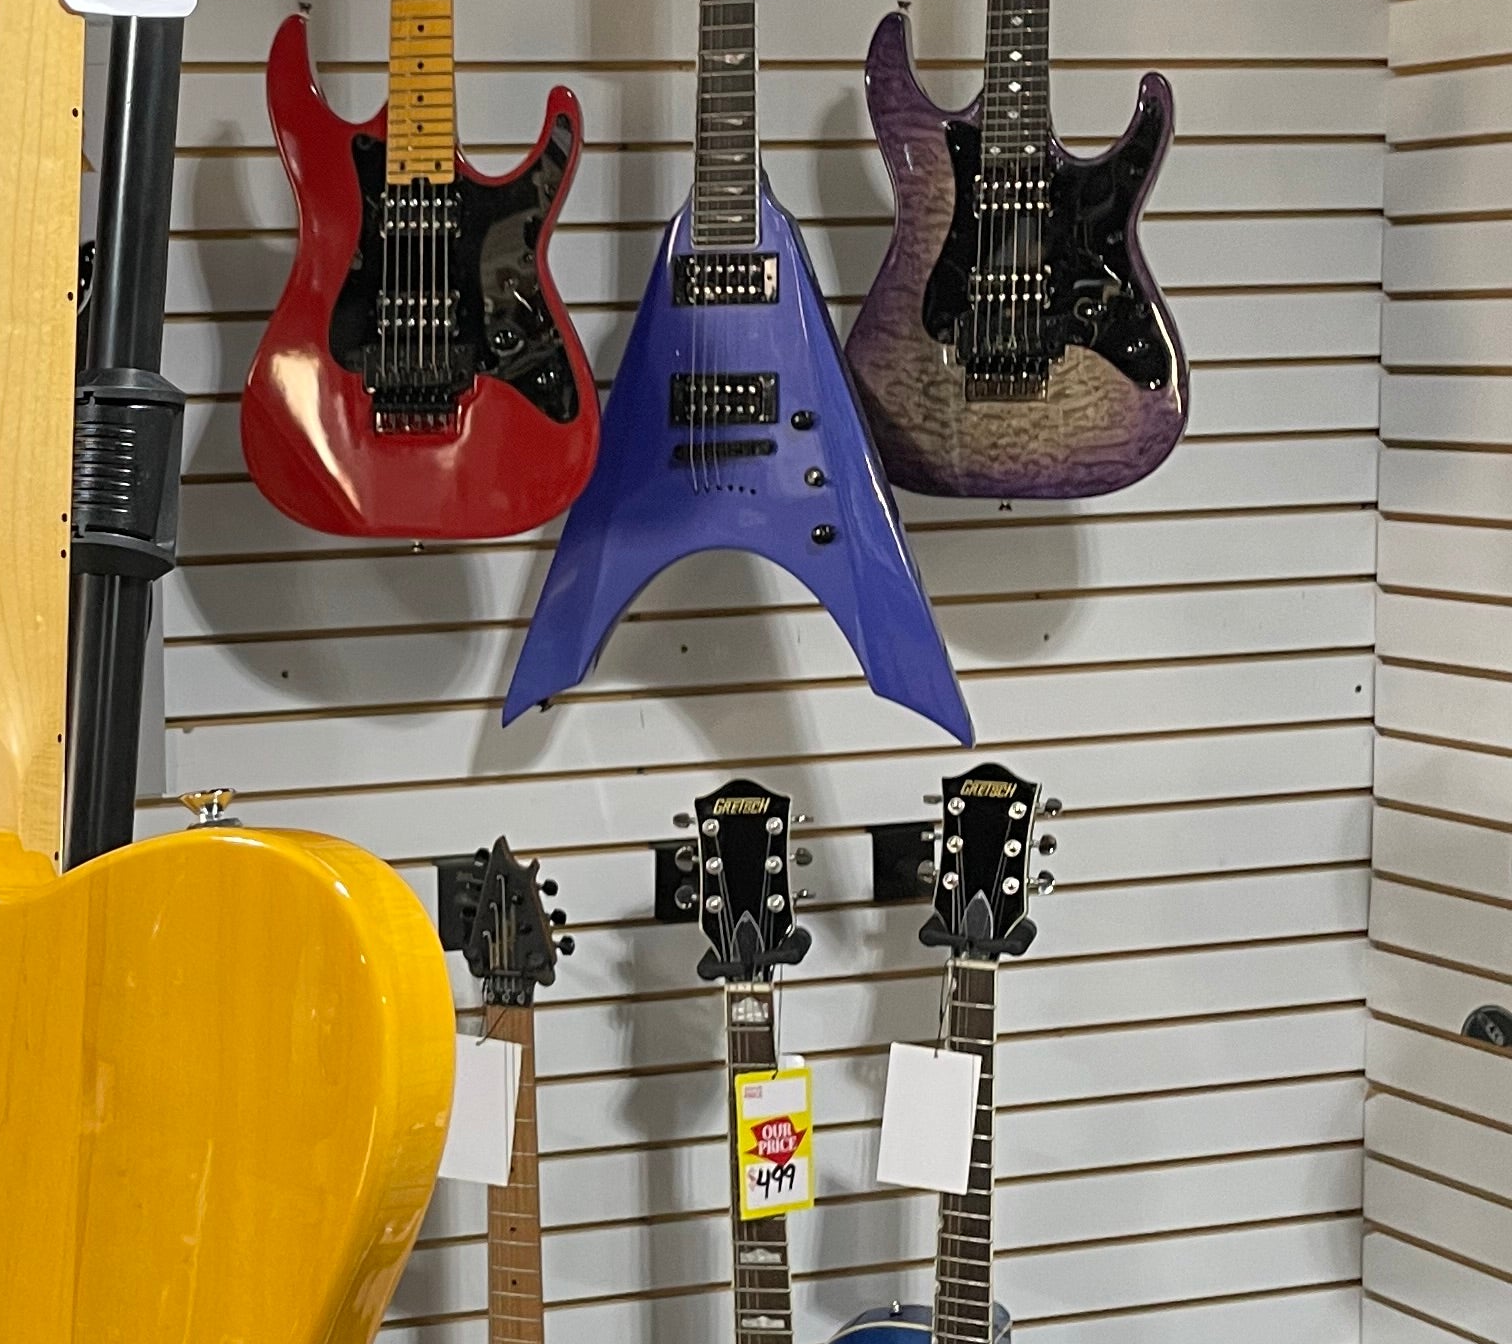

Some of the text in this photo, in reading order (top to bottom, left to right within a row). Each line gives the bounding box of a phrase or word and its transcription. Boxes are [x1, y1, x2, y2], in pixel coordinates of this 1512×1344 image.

[960, 778, 1018, 799] GRETSCH
[713, 797, 771, 816] GRETSCH
[762, 1122, 792, 1141] OUR
[758, 1135, 797, 1156] PRICE
[747, 1163, 796, 1200] $499
